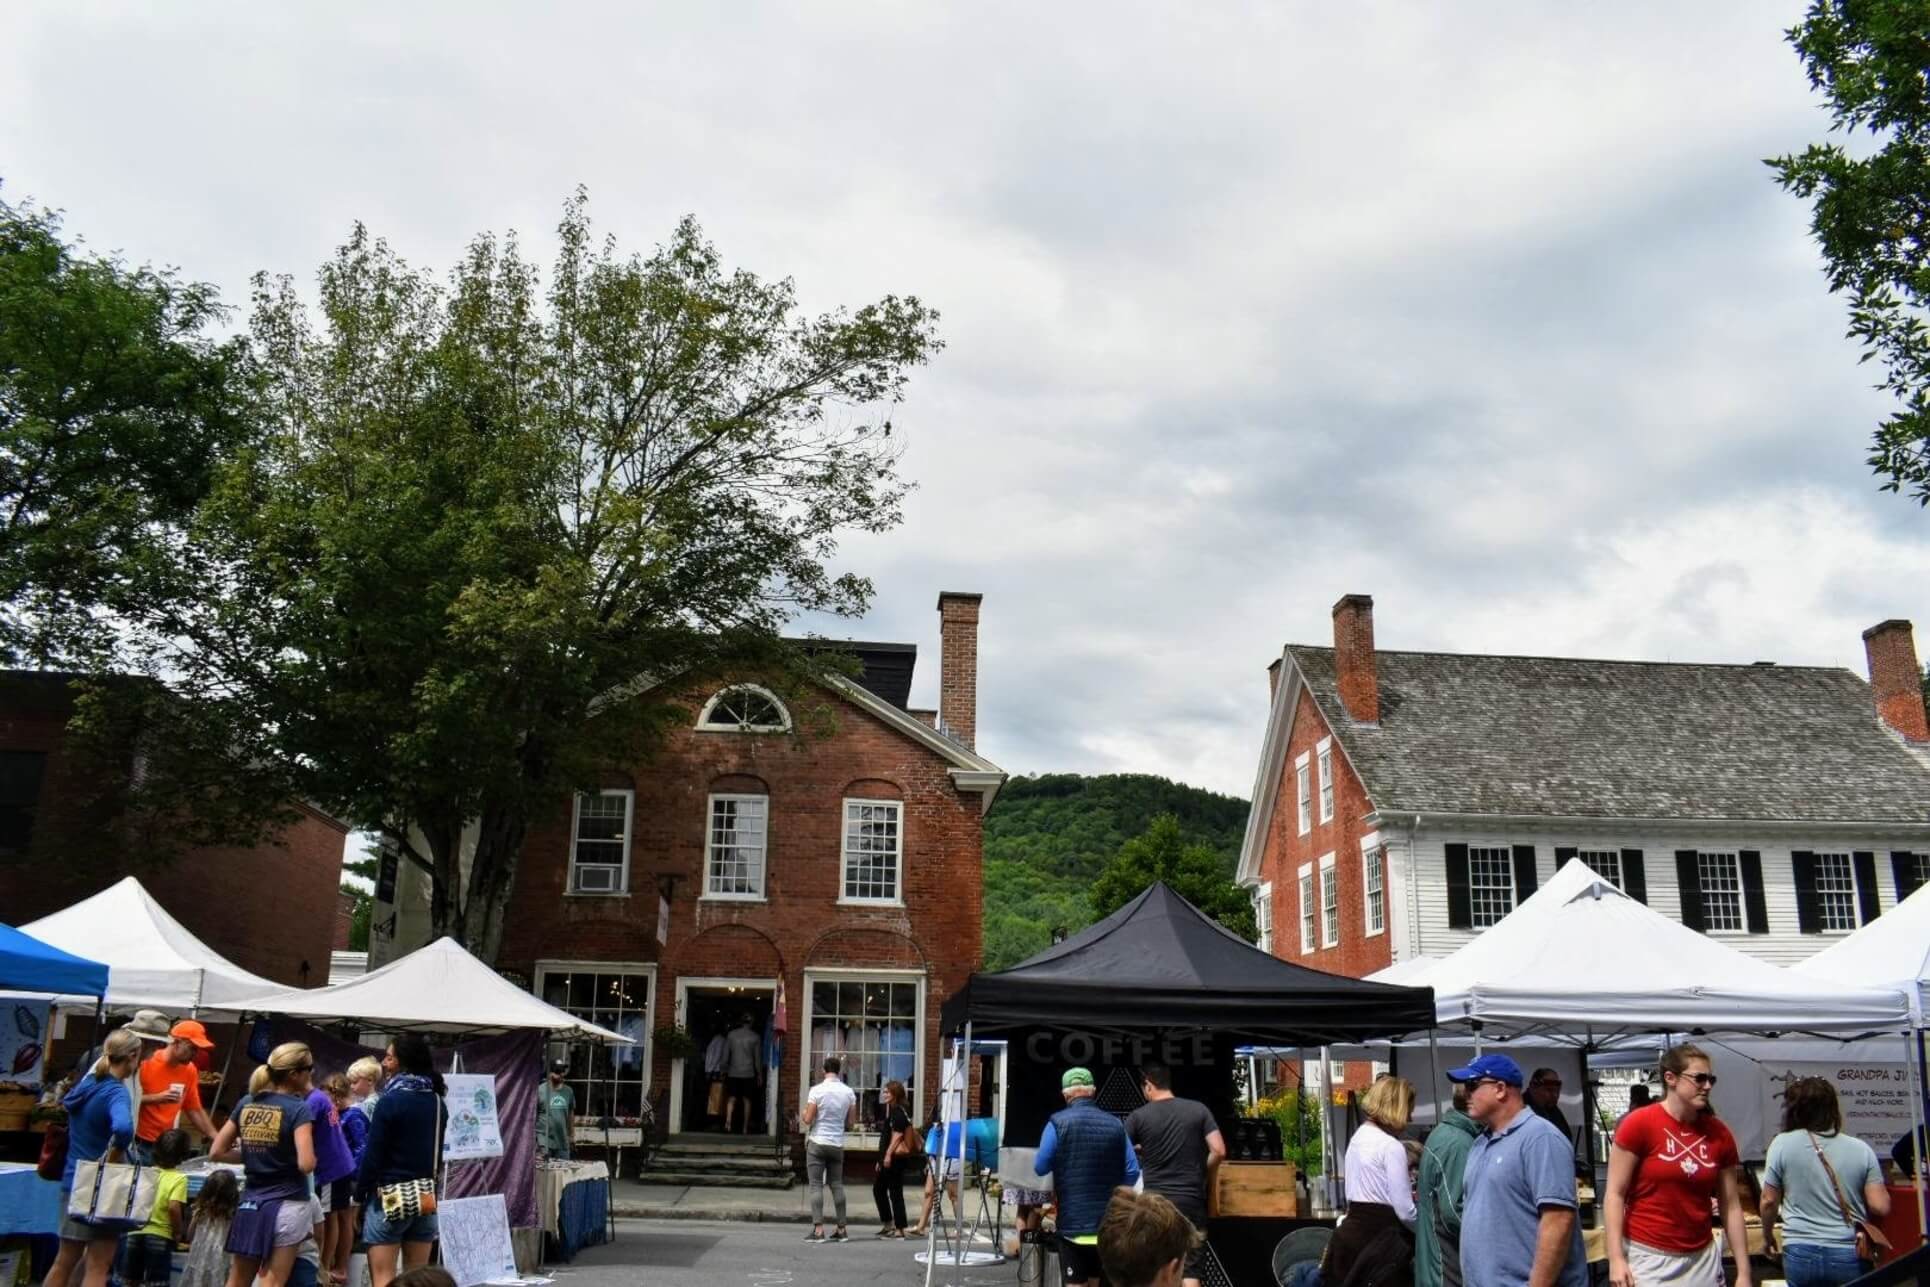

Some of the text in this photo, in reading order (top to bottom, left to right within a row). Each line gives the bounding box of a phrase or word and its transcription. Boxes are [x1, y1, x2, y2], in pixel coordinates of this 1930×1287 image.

[1027, 1031, 1215, 1066] COFFEE
[1837, 1069, 1889, 1081] GRANDPA
[245, 1110, 274, 1127] BBQ
[1666, 1138, 1708, 1159] H C
